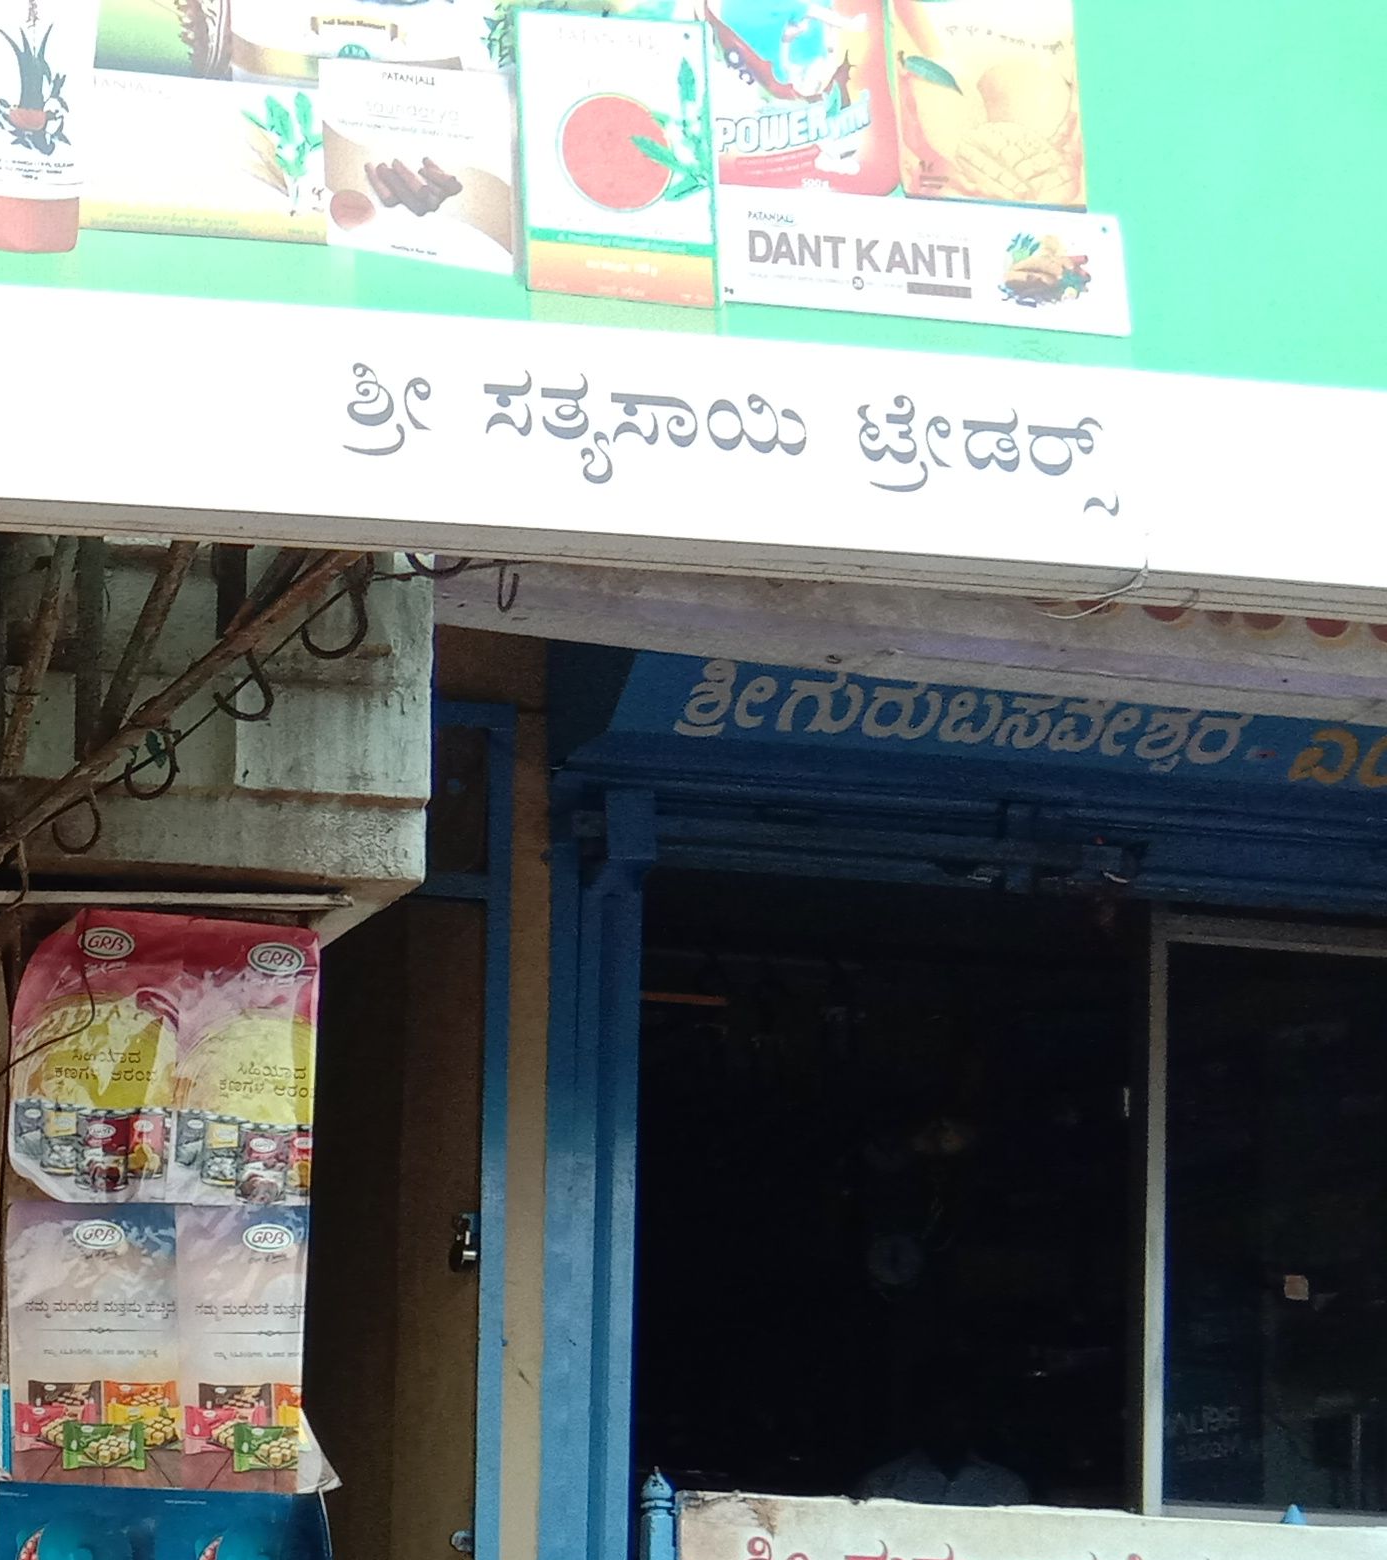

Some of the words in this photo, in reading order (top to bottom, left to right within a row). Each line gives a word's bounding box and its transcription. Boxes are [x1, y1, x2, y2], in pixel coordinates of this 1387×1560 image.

[715, 105, 828, 153] POWER
[747, 228, 848, 269] DANT
[854, 237, 972, 281] KANTI
[342, 360, 433, 457] ಶ್ರೀ
[483, 368, 807, 486] ಸತ್ಯಸಾಯಿ
[272, 1082, 314, 1099] ಆರಂ
